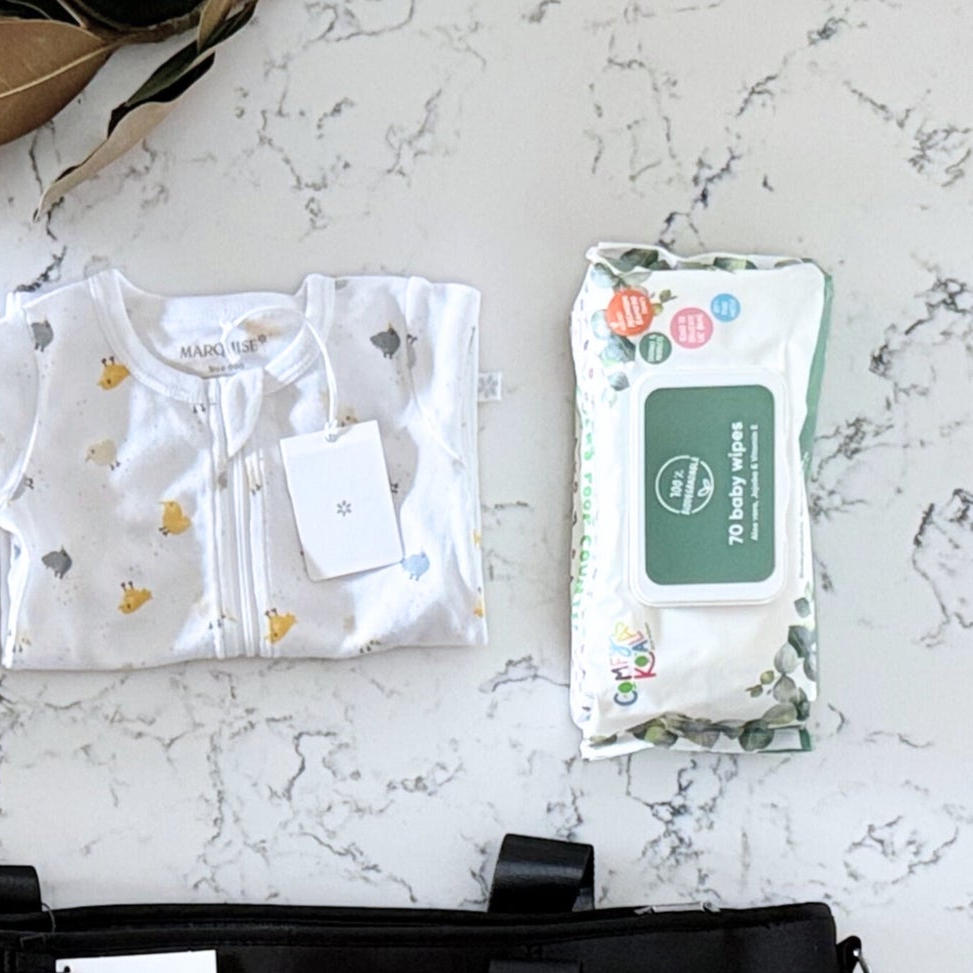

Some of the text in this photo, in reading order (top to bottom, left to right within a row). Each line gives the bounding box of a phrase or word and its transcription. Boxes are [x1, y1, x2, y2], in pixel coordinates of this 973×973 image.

[727, 421, 747, 545] 70 baby wipes
[609, 637, 639, 707] COMFY
